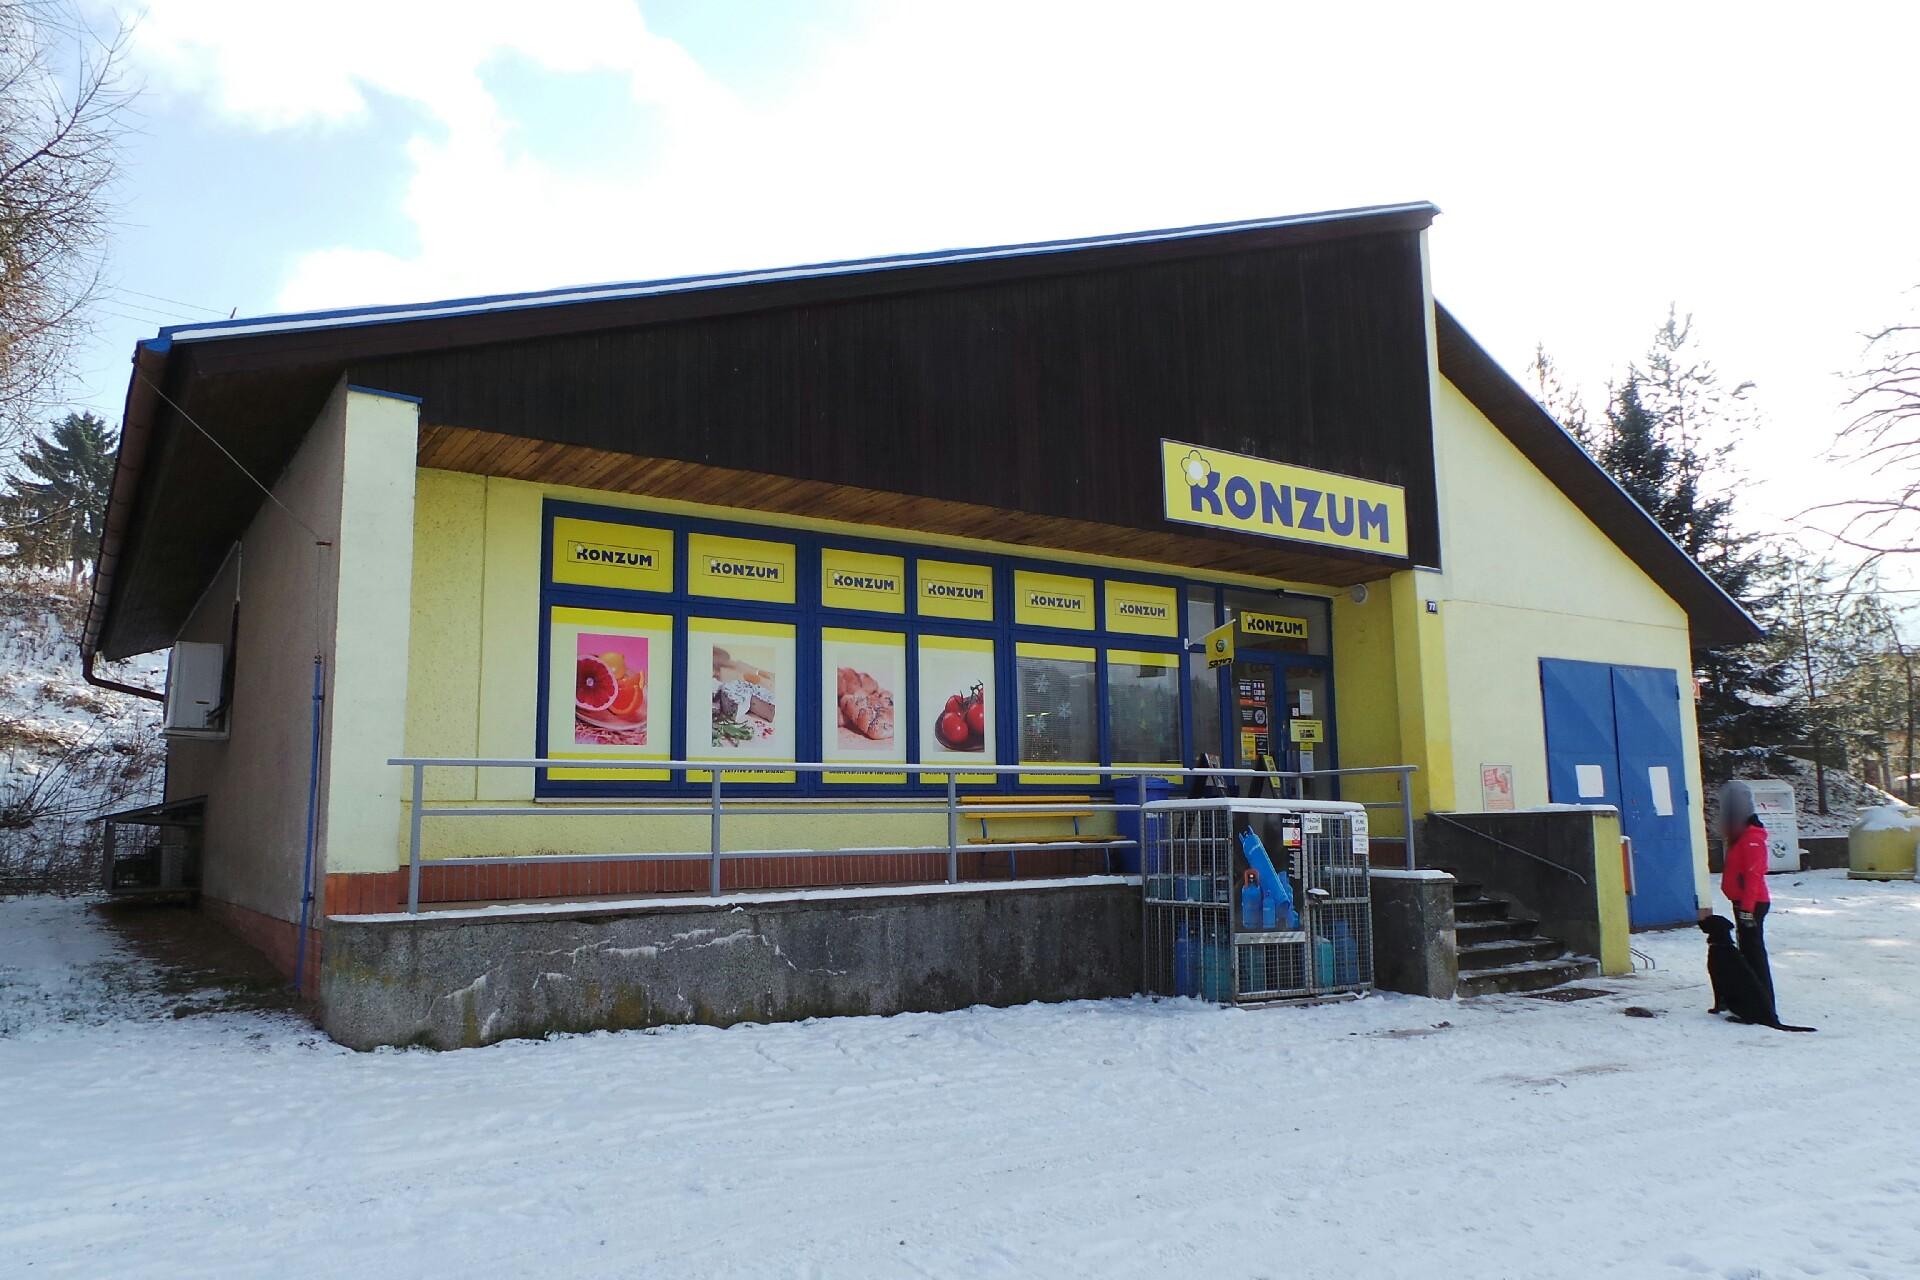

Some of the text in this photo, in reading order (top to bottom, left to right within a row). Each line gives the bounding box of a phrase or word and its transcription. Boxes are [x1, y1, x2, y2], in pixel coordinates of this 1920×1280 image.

[1190, 471, 1389, 543] KONZUM
[577, 549, 652, 567] KONZUM
[710, 562, 779, 579] KONZUM
[834, 575, 894, 590] KONZUM
[928, 584, 984, 599] KONZUM
[1031, 595, 1081, 609] KONZUM
[1120, 604, 1166, 617] KONZUM
[1248, 618, 1303, 635] KONZUM
